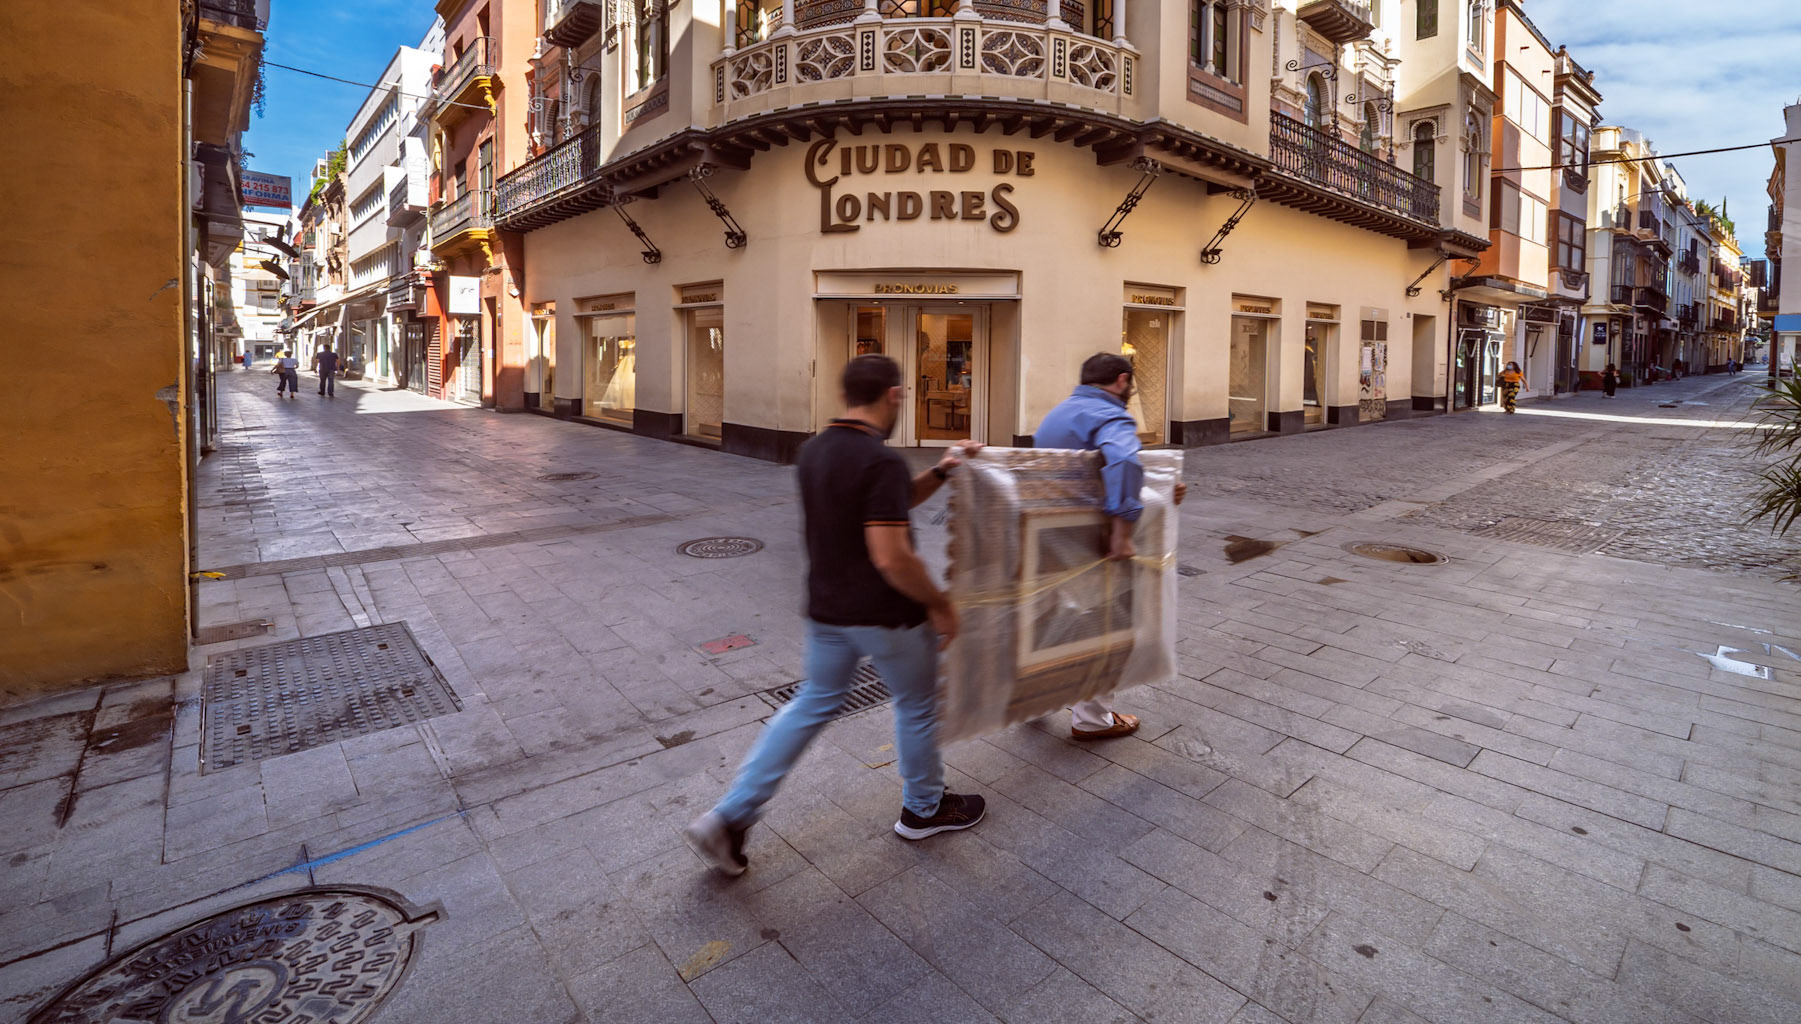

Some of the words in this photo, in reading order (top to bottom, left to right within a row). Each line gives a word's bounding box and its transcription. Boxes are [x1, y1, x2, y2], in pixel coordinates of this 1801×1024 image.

[805, 139, 976, 188] CIUDAD
[993, 149, 1035, 176] DE
[253, 182, 270, 192] 215
[272, 185, 289, 195] 873
[820, 182, 1020, 233] LONDRES
[874, 283, 959, 294] PRONOVIAS
